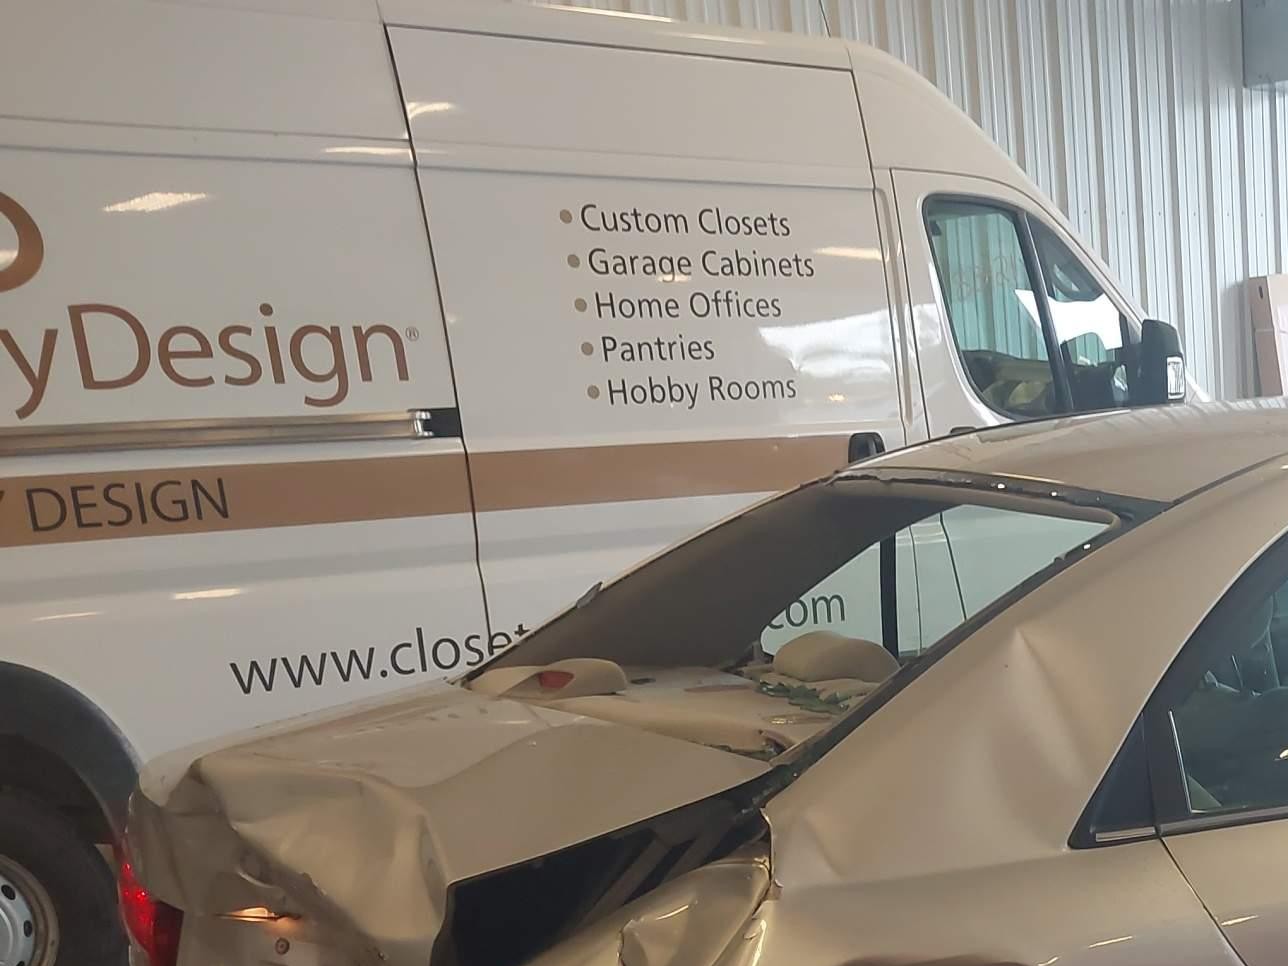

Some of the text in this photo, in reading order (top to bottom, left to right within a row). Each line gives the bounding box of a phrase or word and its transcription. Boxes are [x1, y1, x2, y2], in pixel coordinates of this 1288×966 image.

[580, 204, 791, 237] Custom Closets
[588, 248, 815, 283] Garage Cabinets
[595, 290, 782, 319] Home Offices
[601, 334, 715, 362] Pantries
[607, 375, 797, 410] Hobby Rooms
[25, 478, 229, 532] DESIGN
